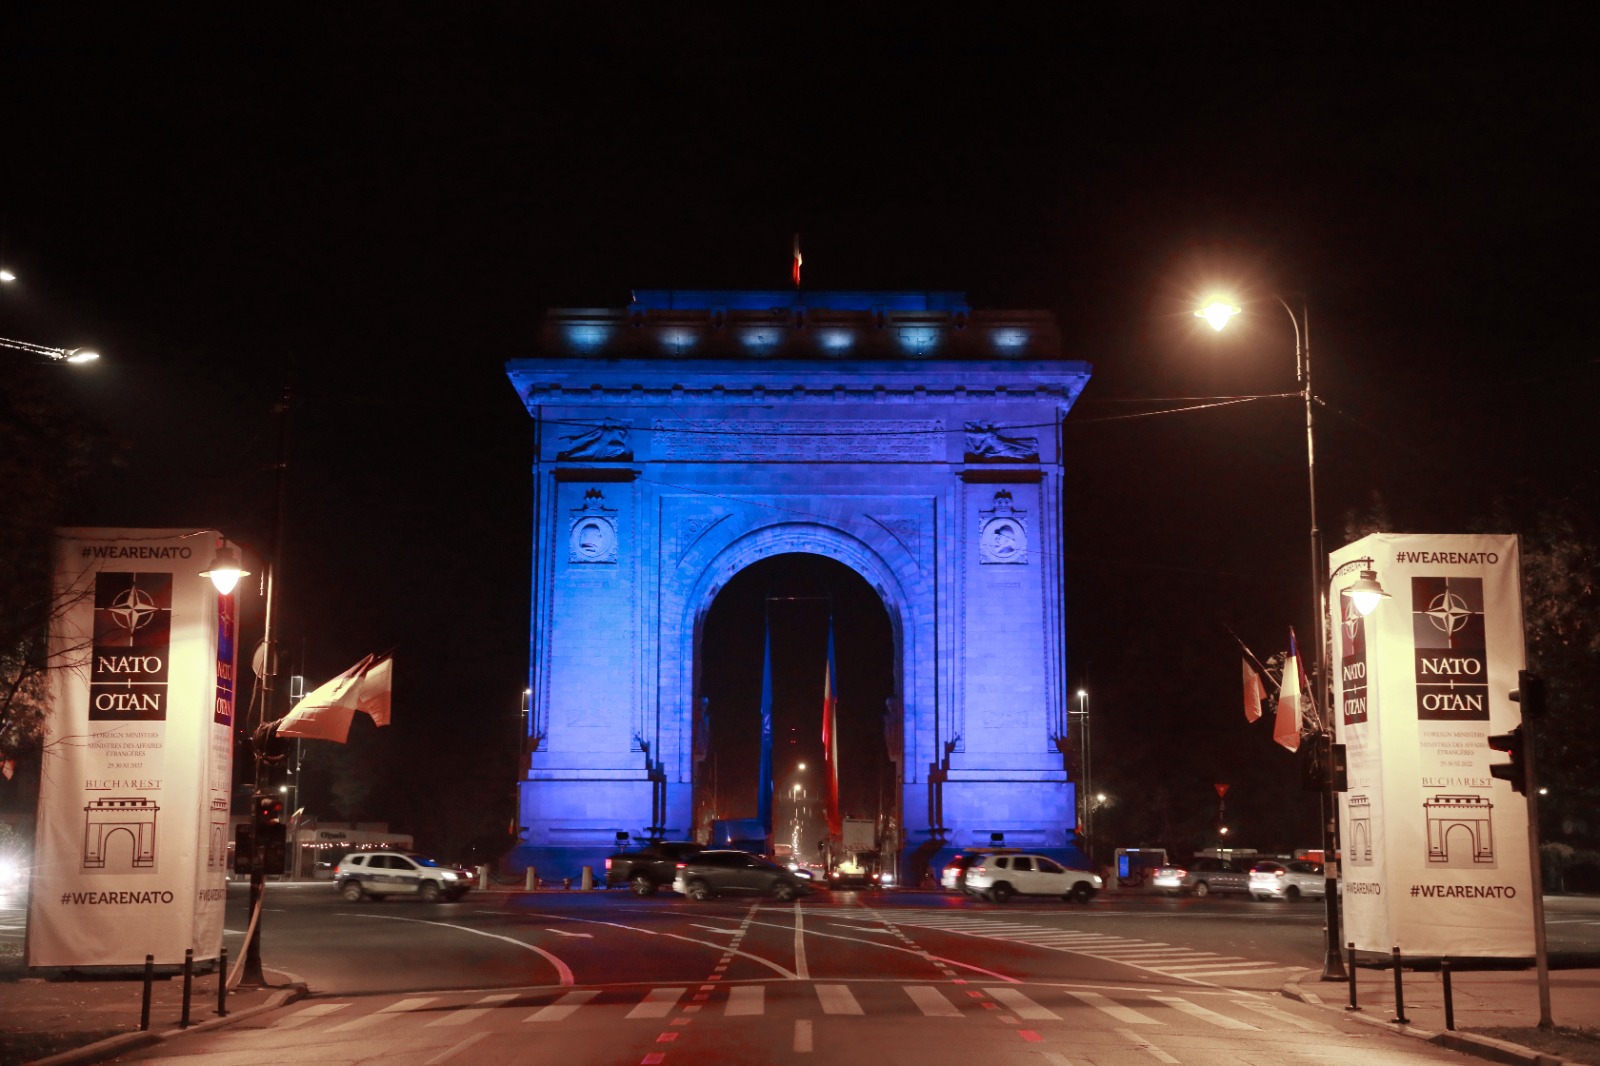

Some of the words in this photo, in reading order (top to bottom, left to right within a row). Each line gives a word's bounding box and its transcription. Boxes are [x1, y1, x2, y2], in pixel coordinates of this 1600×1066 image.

[81, 546, 192, 559] #WEARENATO
[1396, 551, 1499, 565] #WEARENATO
[97, 656, 162, 673] NATO
[1343, 661, 1366, 682] NATO
[1421, 658, 1481, 675] NATO
[95, 693, 161, 711] OTAN
[1344, 697, 1367, 716] OTAN
[1422, 694, 1483, 711] OTAN
[85, 779, 163, 788] BUCHAREST
[1422, 777, 1493, 786] BUCHAREST
[60, 890, 174, 905] #WEARENATO
[1410, 885, 1516, 899] #WEARENATO
